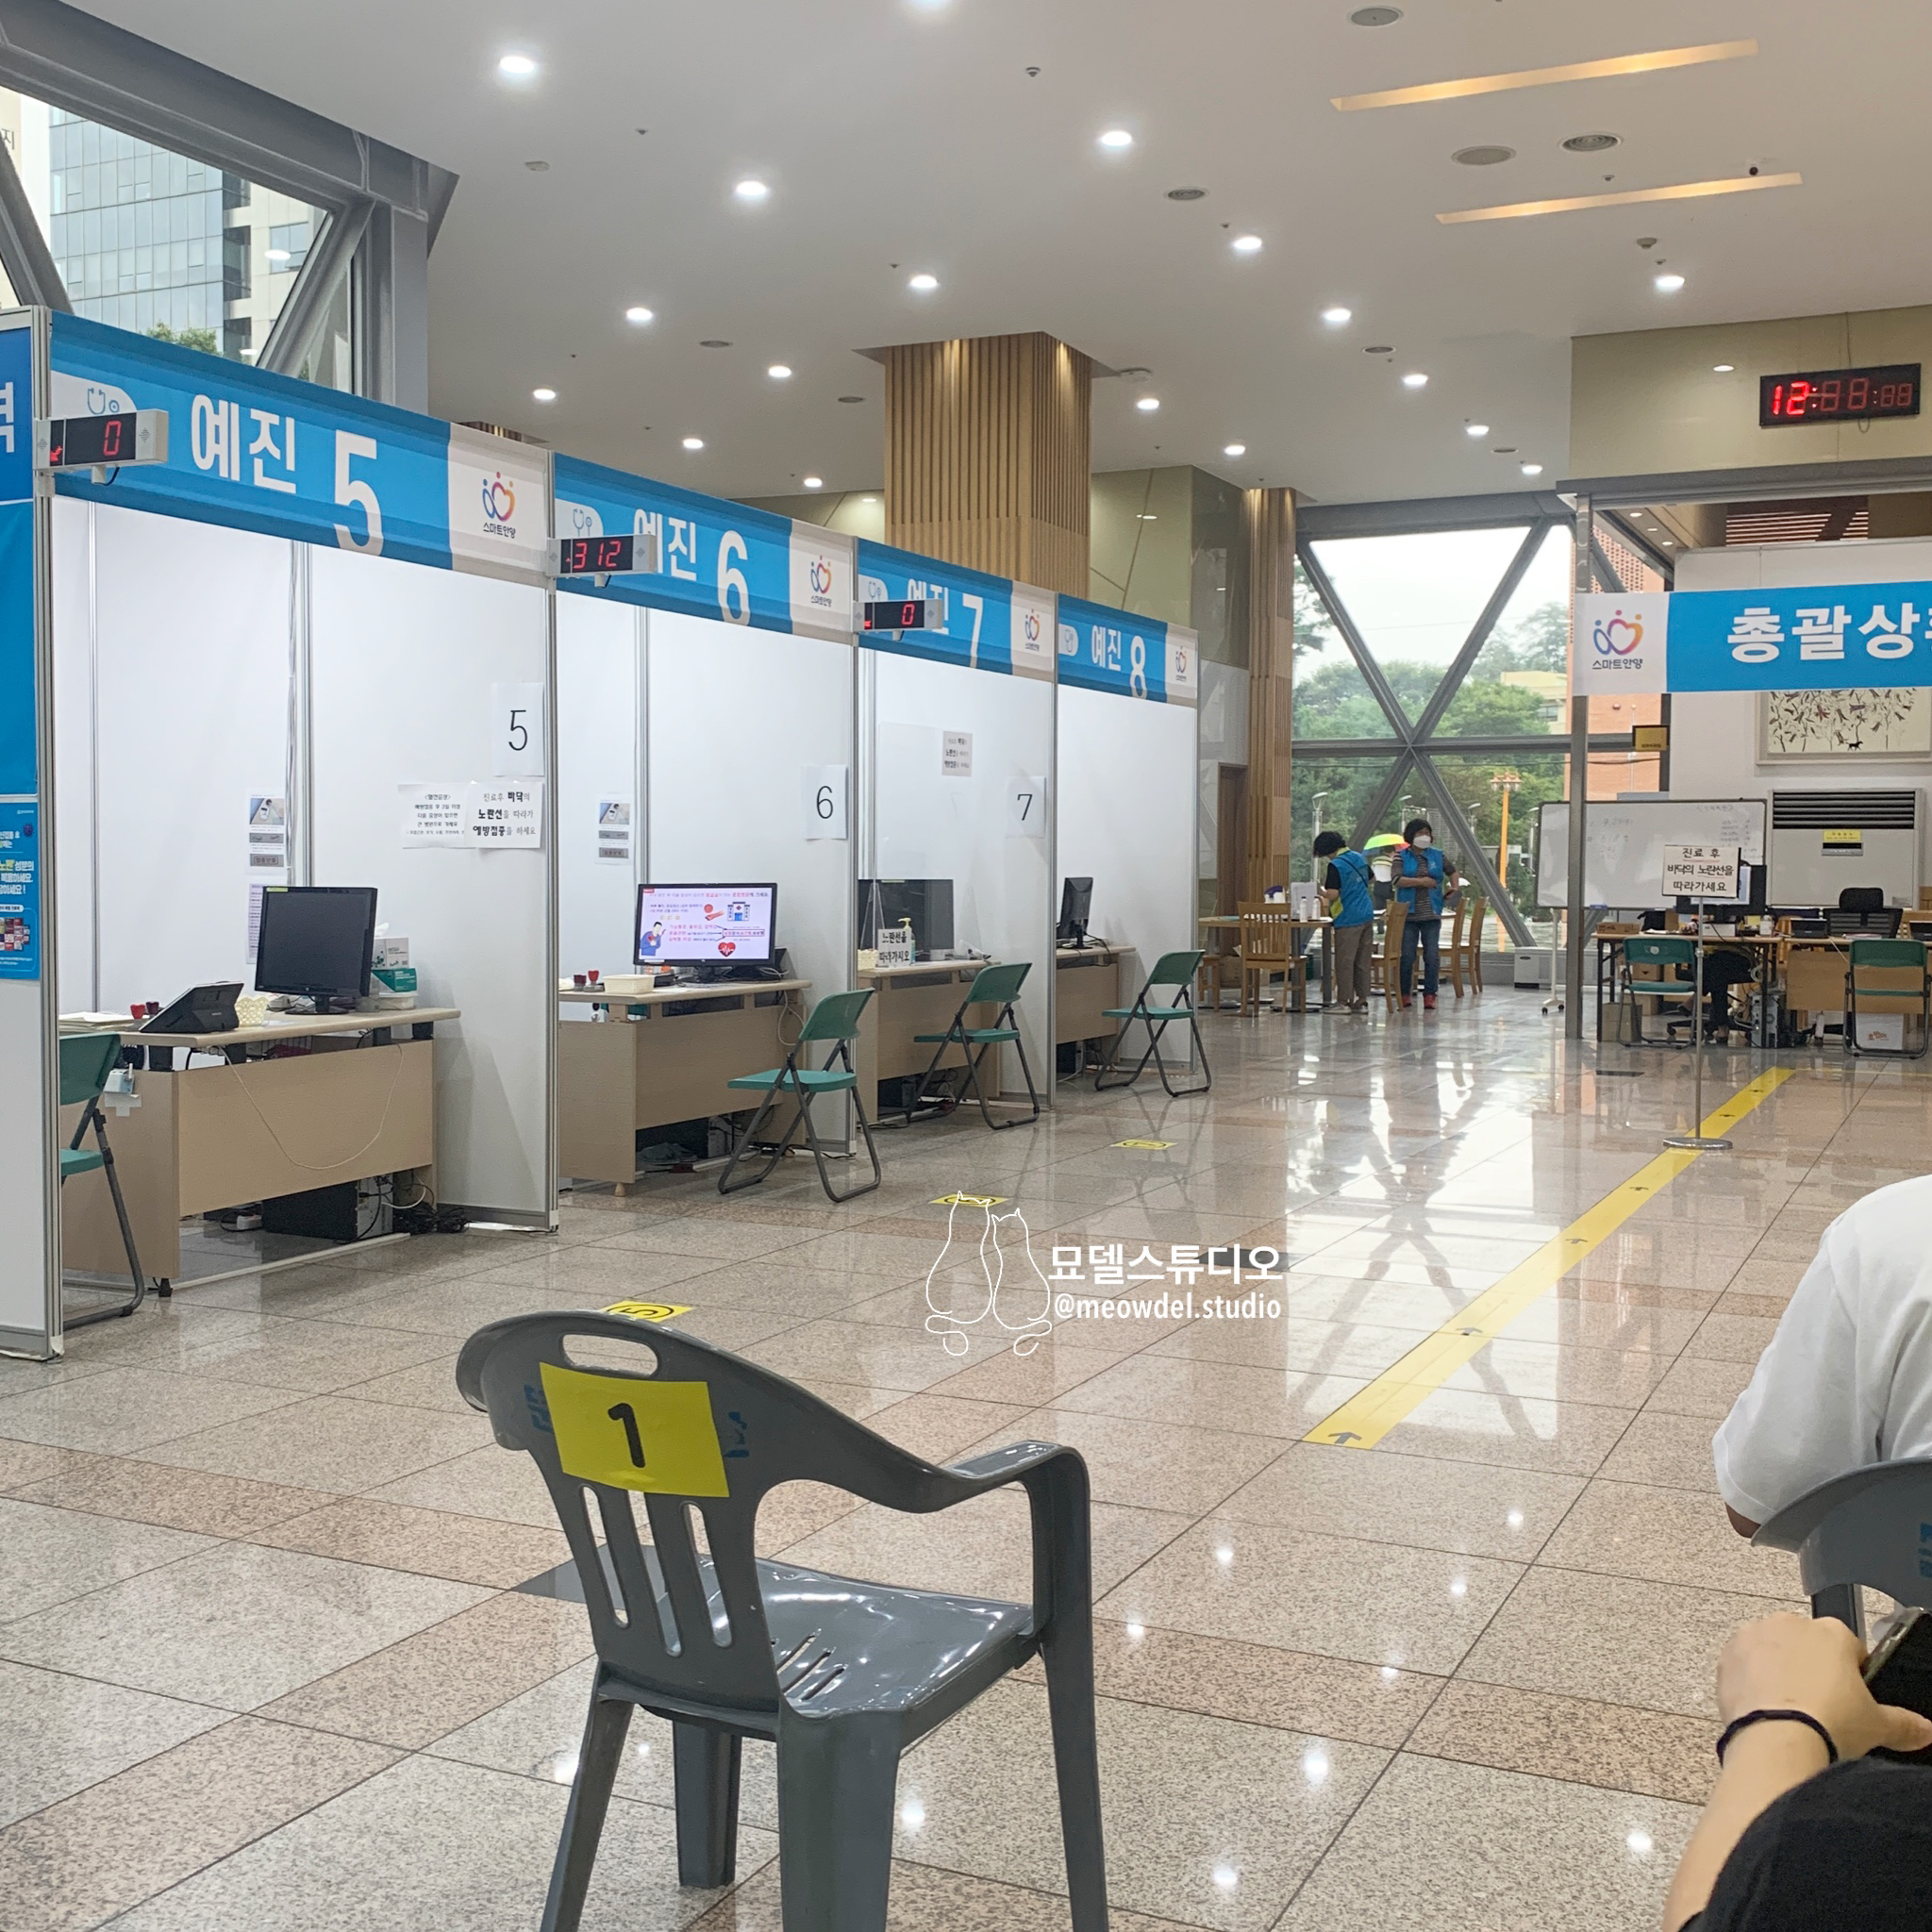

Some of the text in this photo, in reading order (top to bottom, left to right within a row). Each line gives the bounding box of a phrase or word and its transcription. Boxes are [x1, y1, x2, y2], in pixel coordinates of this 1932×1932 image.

[103, 421, 121, 457] 0
[191, 393, 383, 557] 예진 5
[482, 524, 516, 539] 스마트안양
[718, 530, 750, 626] 6
[902, 603, 914, 625] 0
[962, 593, 983, 670] 7
[1726, 602, 1932, 664] 총괄상
[1091, 625, 1147, 700] 예진 8
[1591, 658, 1643, 671] 스마트안양
[508, 709, 528, 751] 5
[508, 791, 530, 803] 바닥의
[816, 785, 834, 819] 6
[1017, 793, 1033, 821] 7
[478, 808, 534, 820] 노란선을 따라가
[473, 825, 513, 837] 예방접종을
[516, 826, 536, 836] 하세요
[1682, 847, 1721, 858] 진료 후
[1667, 864, 1734, 876] 바닥의 노란선을
[1673, 881, 1727, 892] 따라가세요
[882, 931, 908, 943] 노란선을
[879, 950, 909, 963] 따라가시오
[608, 1403, 646, 1469] 1
